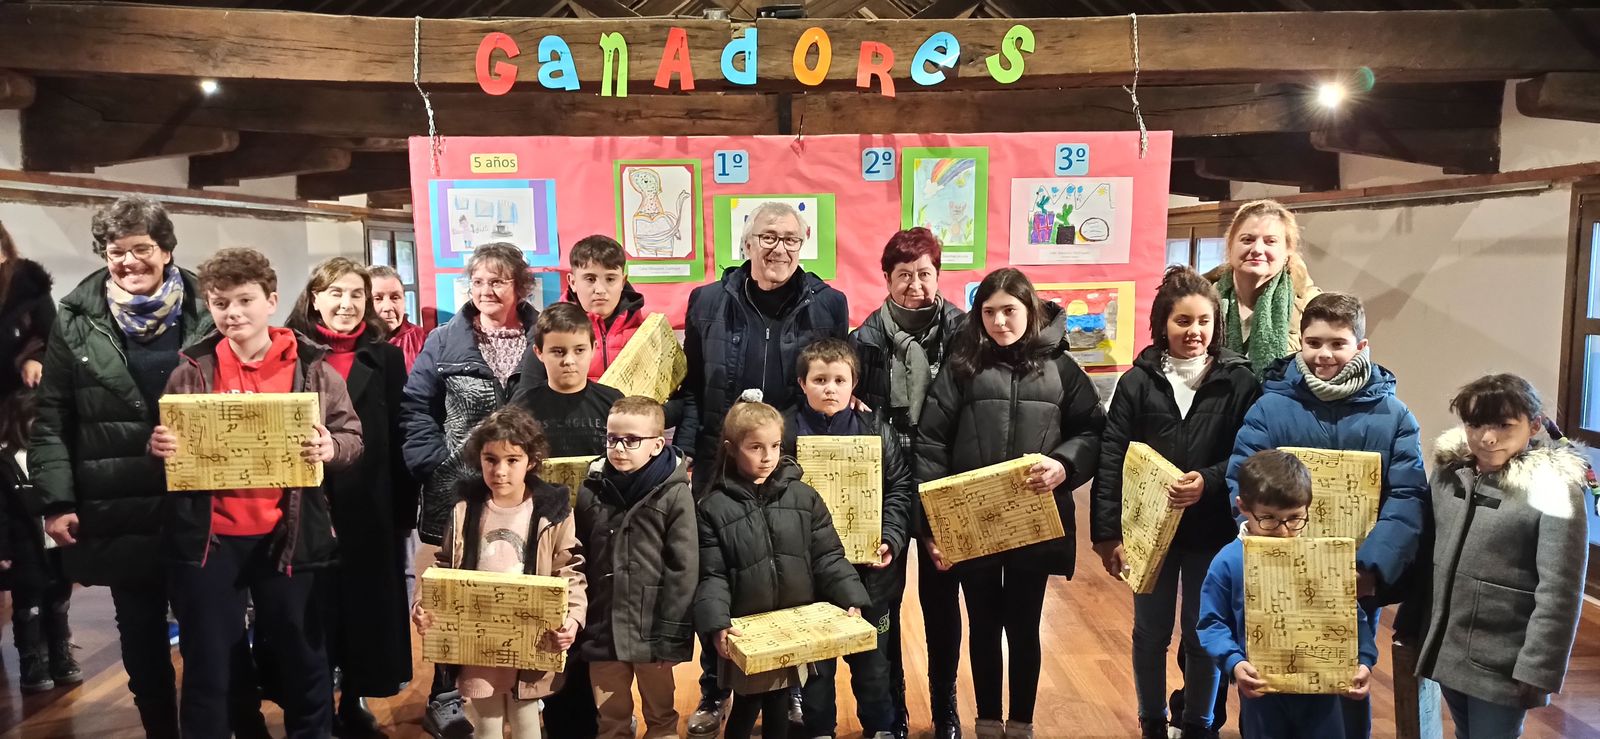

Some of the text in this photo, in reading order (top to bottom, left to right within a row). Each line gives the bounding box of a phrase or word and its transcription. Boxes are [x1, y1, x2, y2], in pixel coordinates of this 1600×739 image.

[474, 156, 516, 168] 5 años
[718, 153, 743, 176] 1º
[865, 150, 892, 174] 2º
[1059, 147, 1086, 171] 3º
